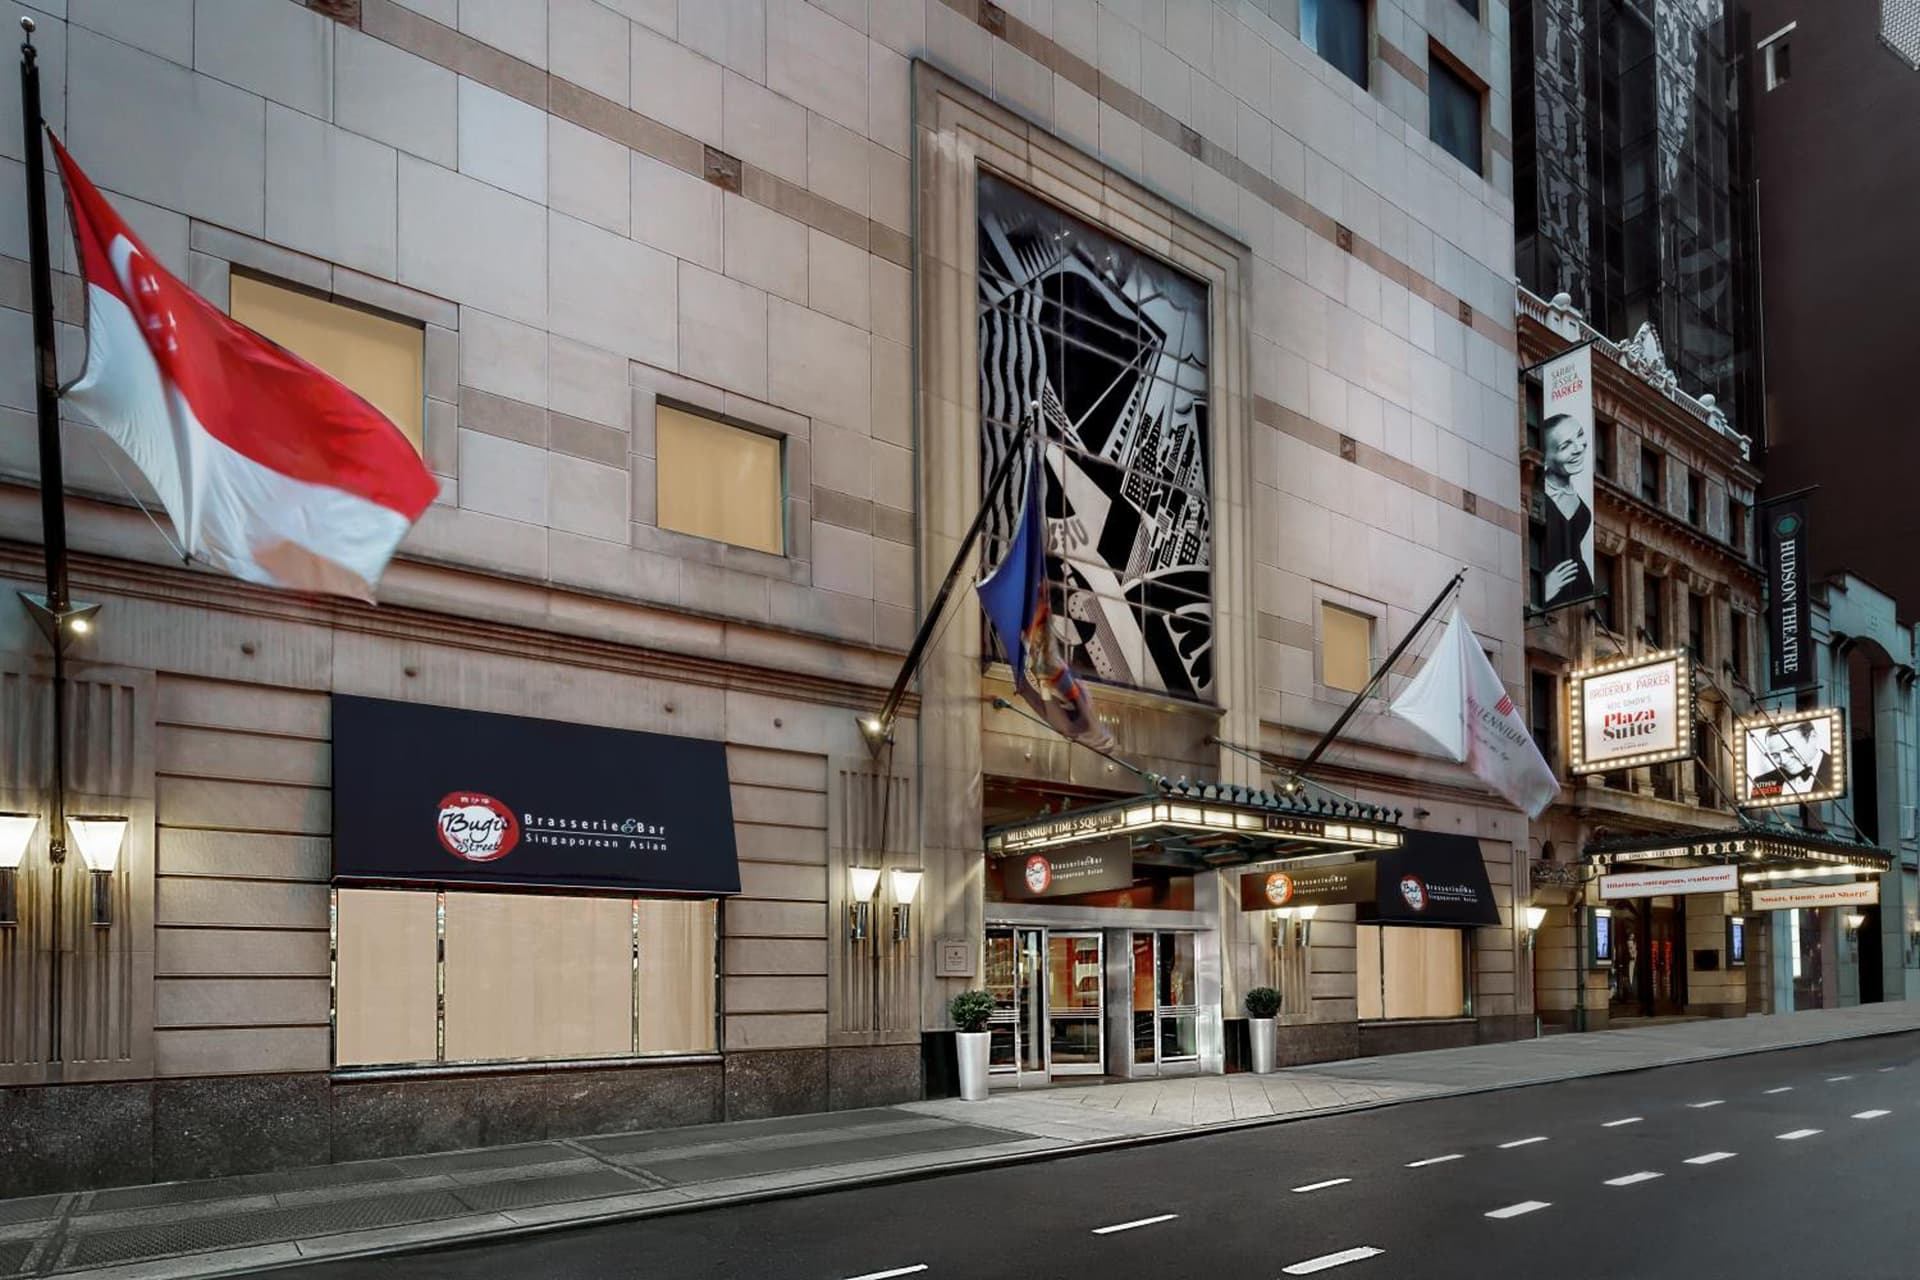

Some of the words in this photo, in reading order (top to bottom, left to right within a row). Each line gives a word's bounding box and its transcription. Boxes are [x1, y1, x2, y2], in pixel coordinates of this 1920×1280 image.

[1552, 379, 1583, 400] PARKER
[1780, 539, 1797, 602] HUDSON
[1782, 603, 1798, 674] THEATRE
[1636, 673, 1670, 690] PARKER
[1467, 695, 1528, 747] MILLENNIUM
[1605, 709, 1655, 728] Plaza
[1602, 722, 1657, 742] Suite
[1007, 825, 1053, 842] MILLENNIUM
[1055, 820, 1078, 835] TIMES
[1080, 815, 1114, 829] SQUARE
[525, 832, 619, 848] Singaporean
[629, 840, 668, 852] Asian
[1818, 891, 1837, 899] and
[1838, 889, 1869, 899] Sharp!
